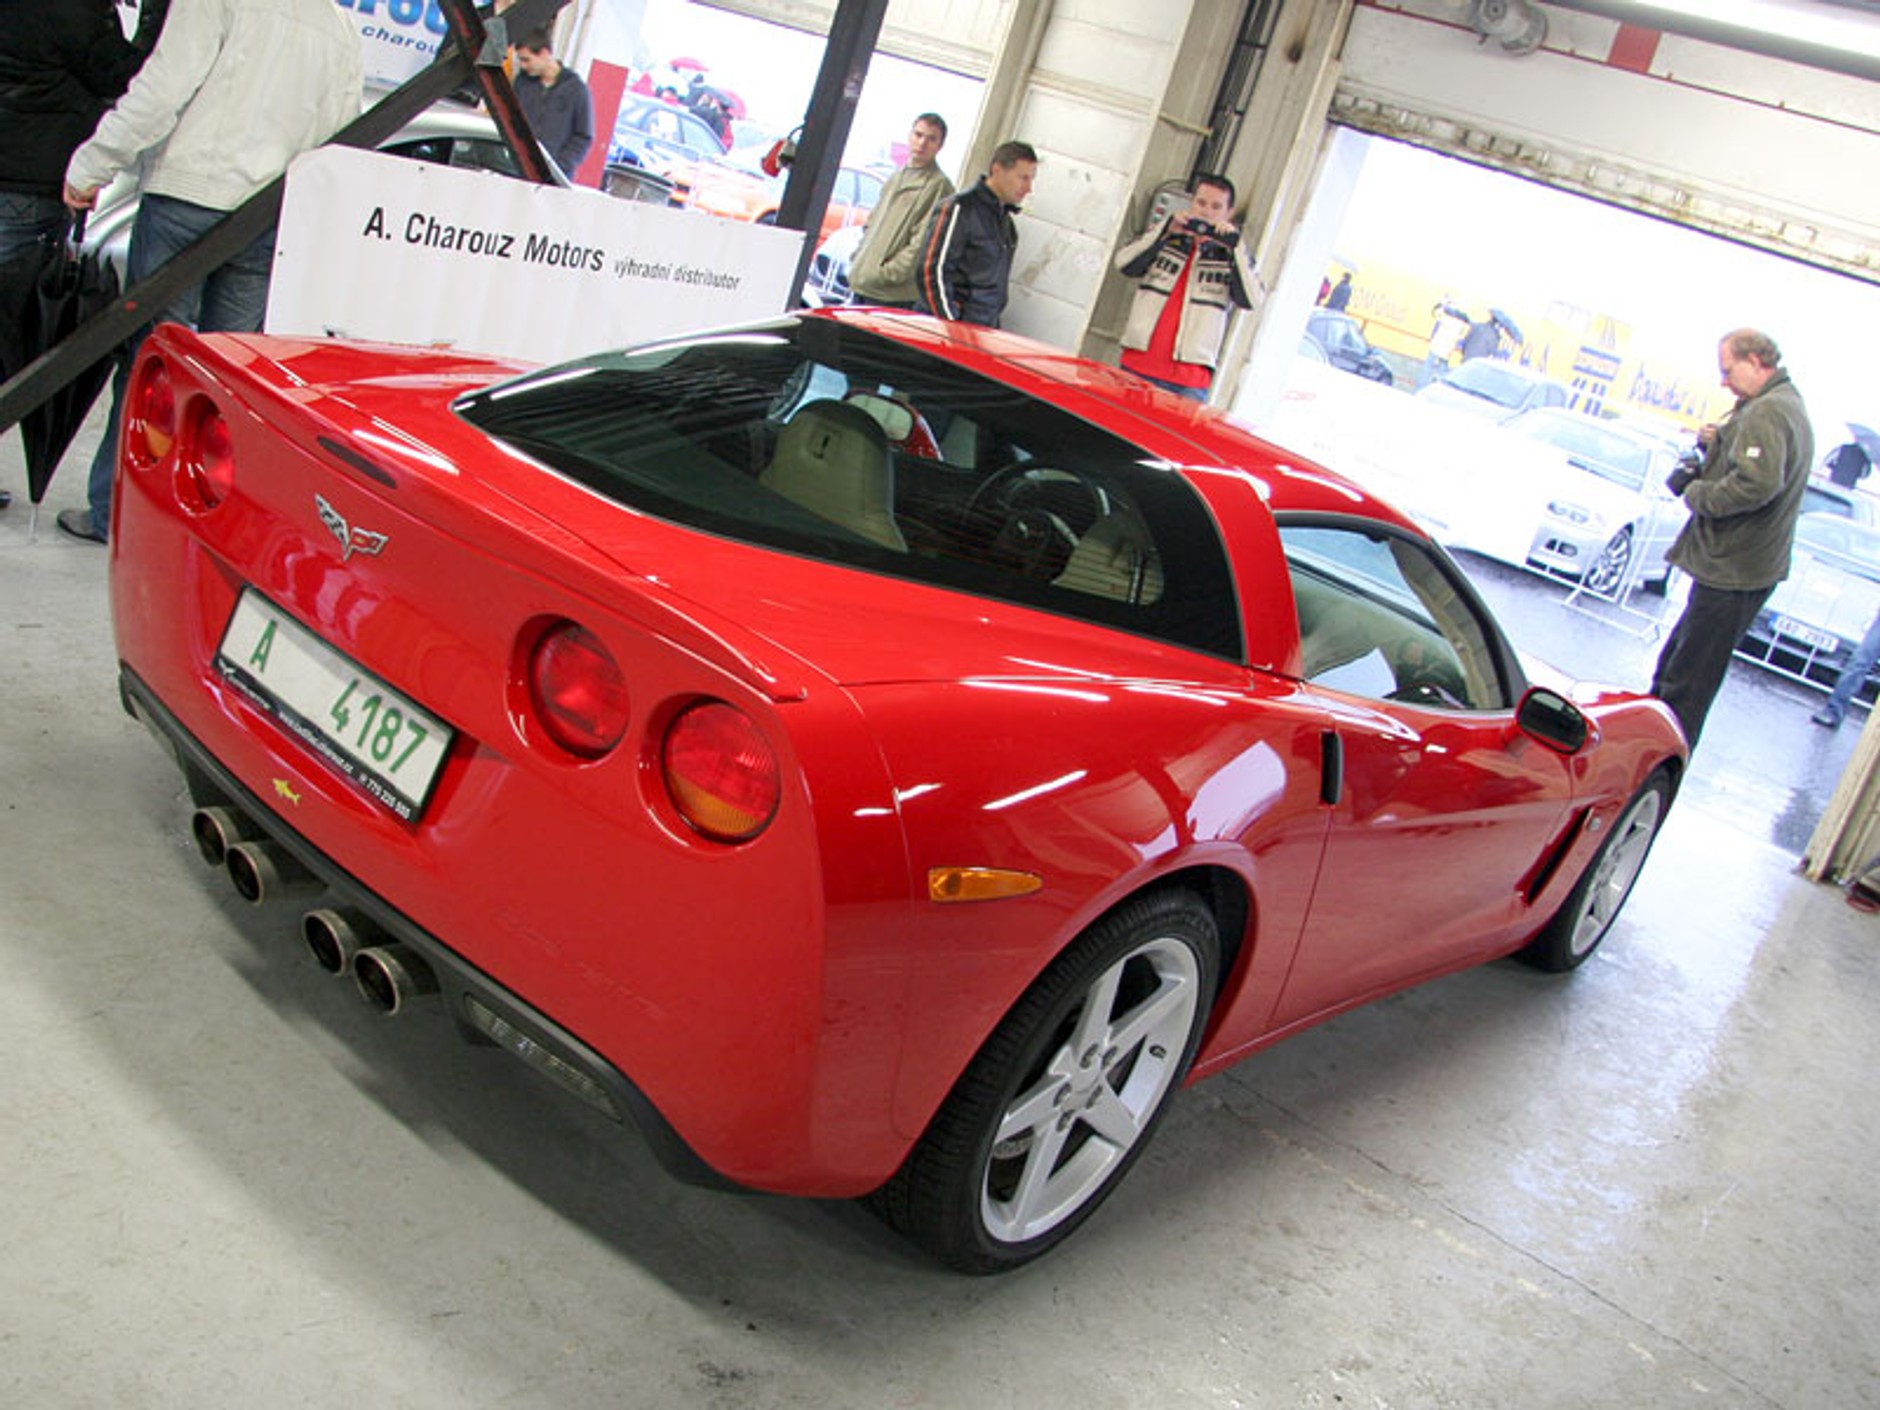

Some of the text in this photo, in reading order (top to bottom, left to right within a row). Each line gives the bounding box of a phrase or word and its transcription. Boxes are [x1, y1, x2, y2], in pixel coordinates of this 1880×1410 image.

[363, 207, 392, 240] A.
[405, 213, 515, 258] Charouz
[523, 233, 605, 271] Motors
[673, 266, 740, 290] distributor
[250, 619, 277, 673] A
[330, 678, 428, 774] 4187
